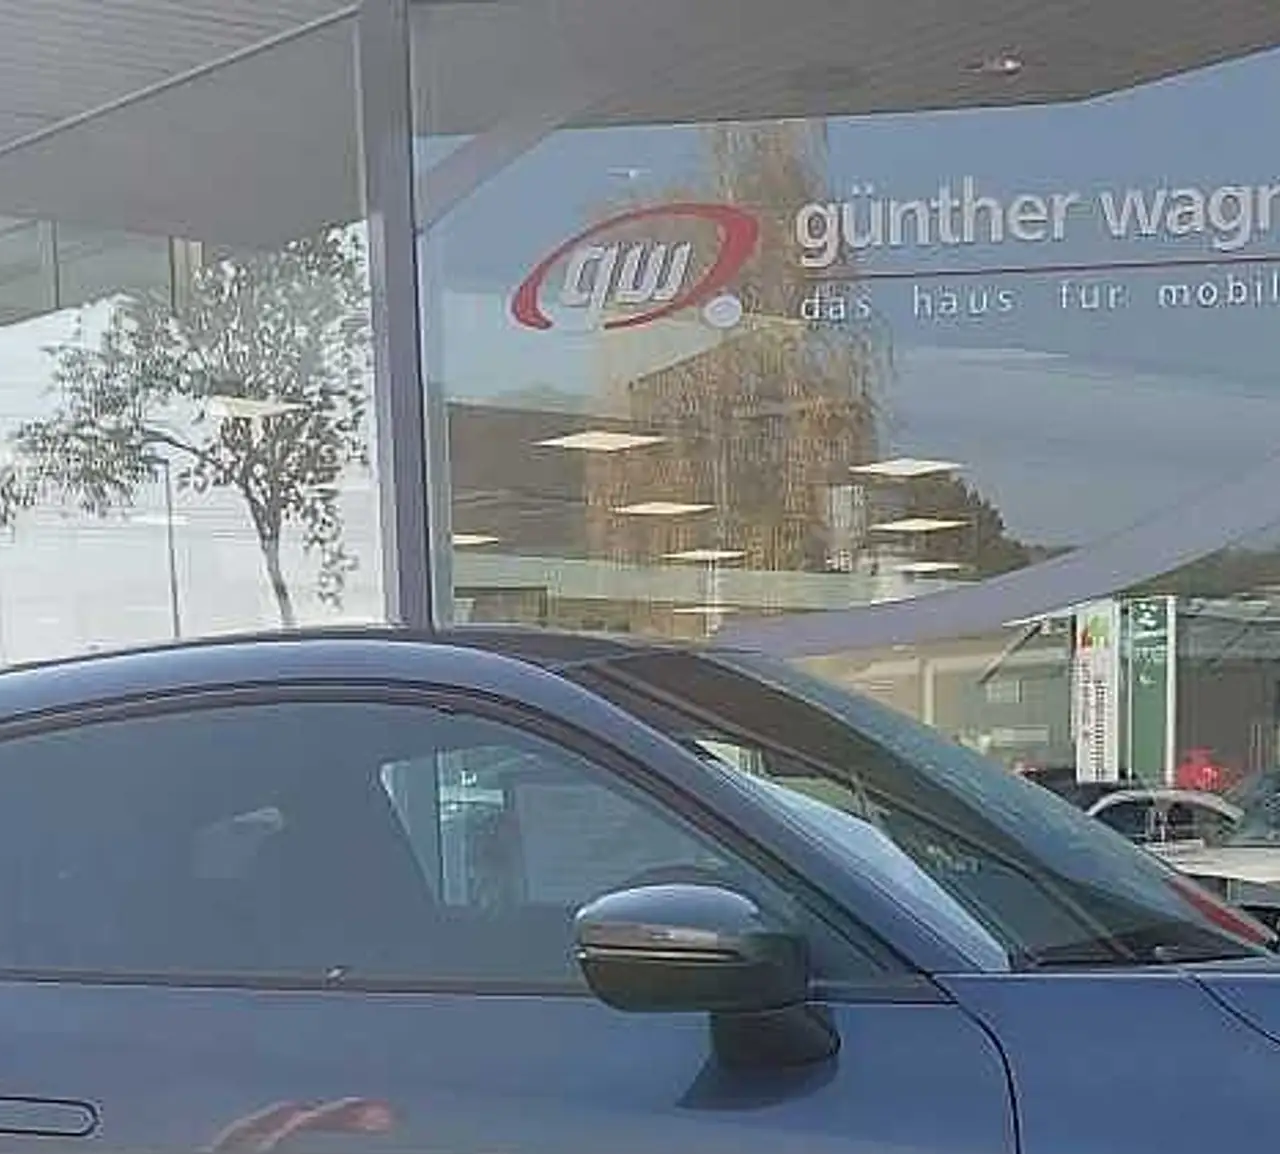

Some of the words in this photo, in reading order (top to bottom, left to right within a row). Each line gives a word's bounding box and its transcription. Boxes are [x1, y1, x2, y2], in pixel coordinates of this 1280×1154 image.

[795, 177, 1078, 268] günther
[800, 281, 871, 320] das
[914, 284, 1013, 318] haus
